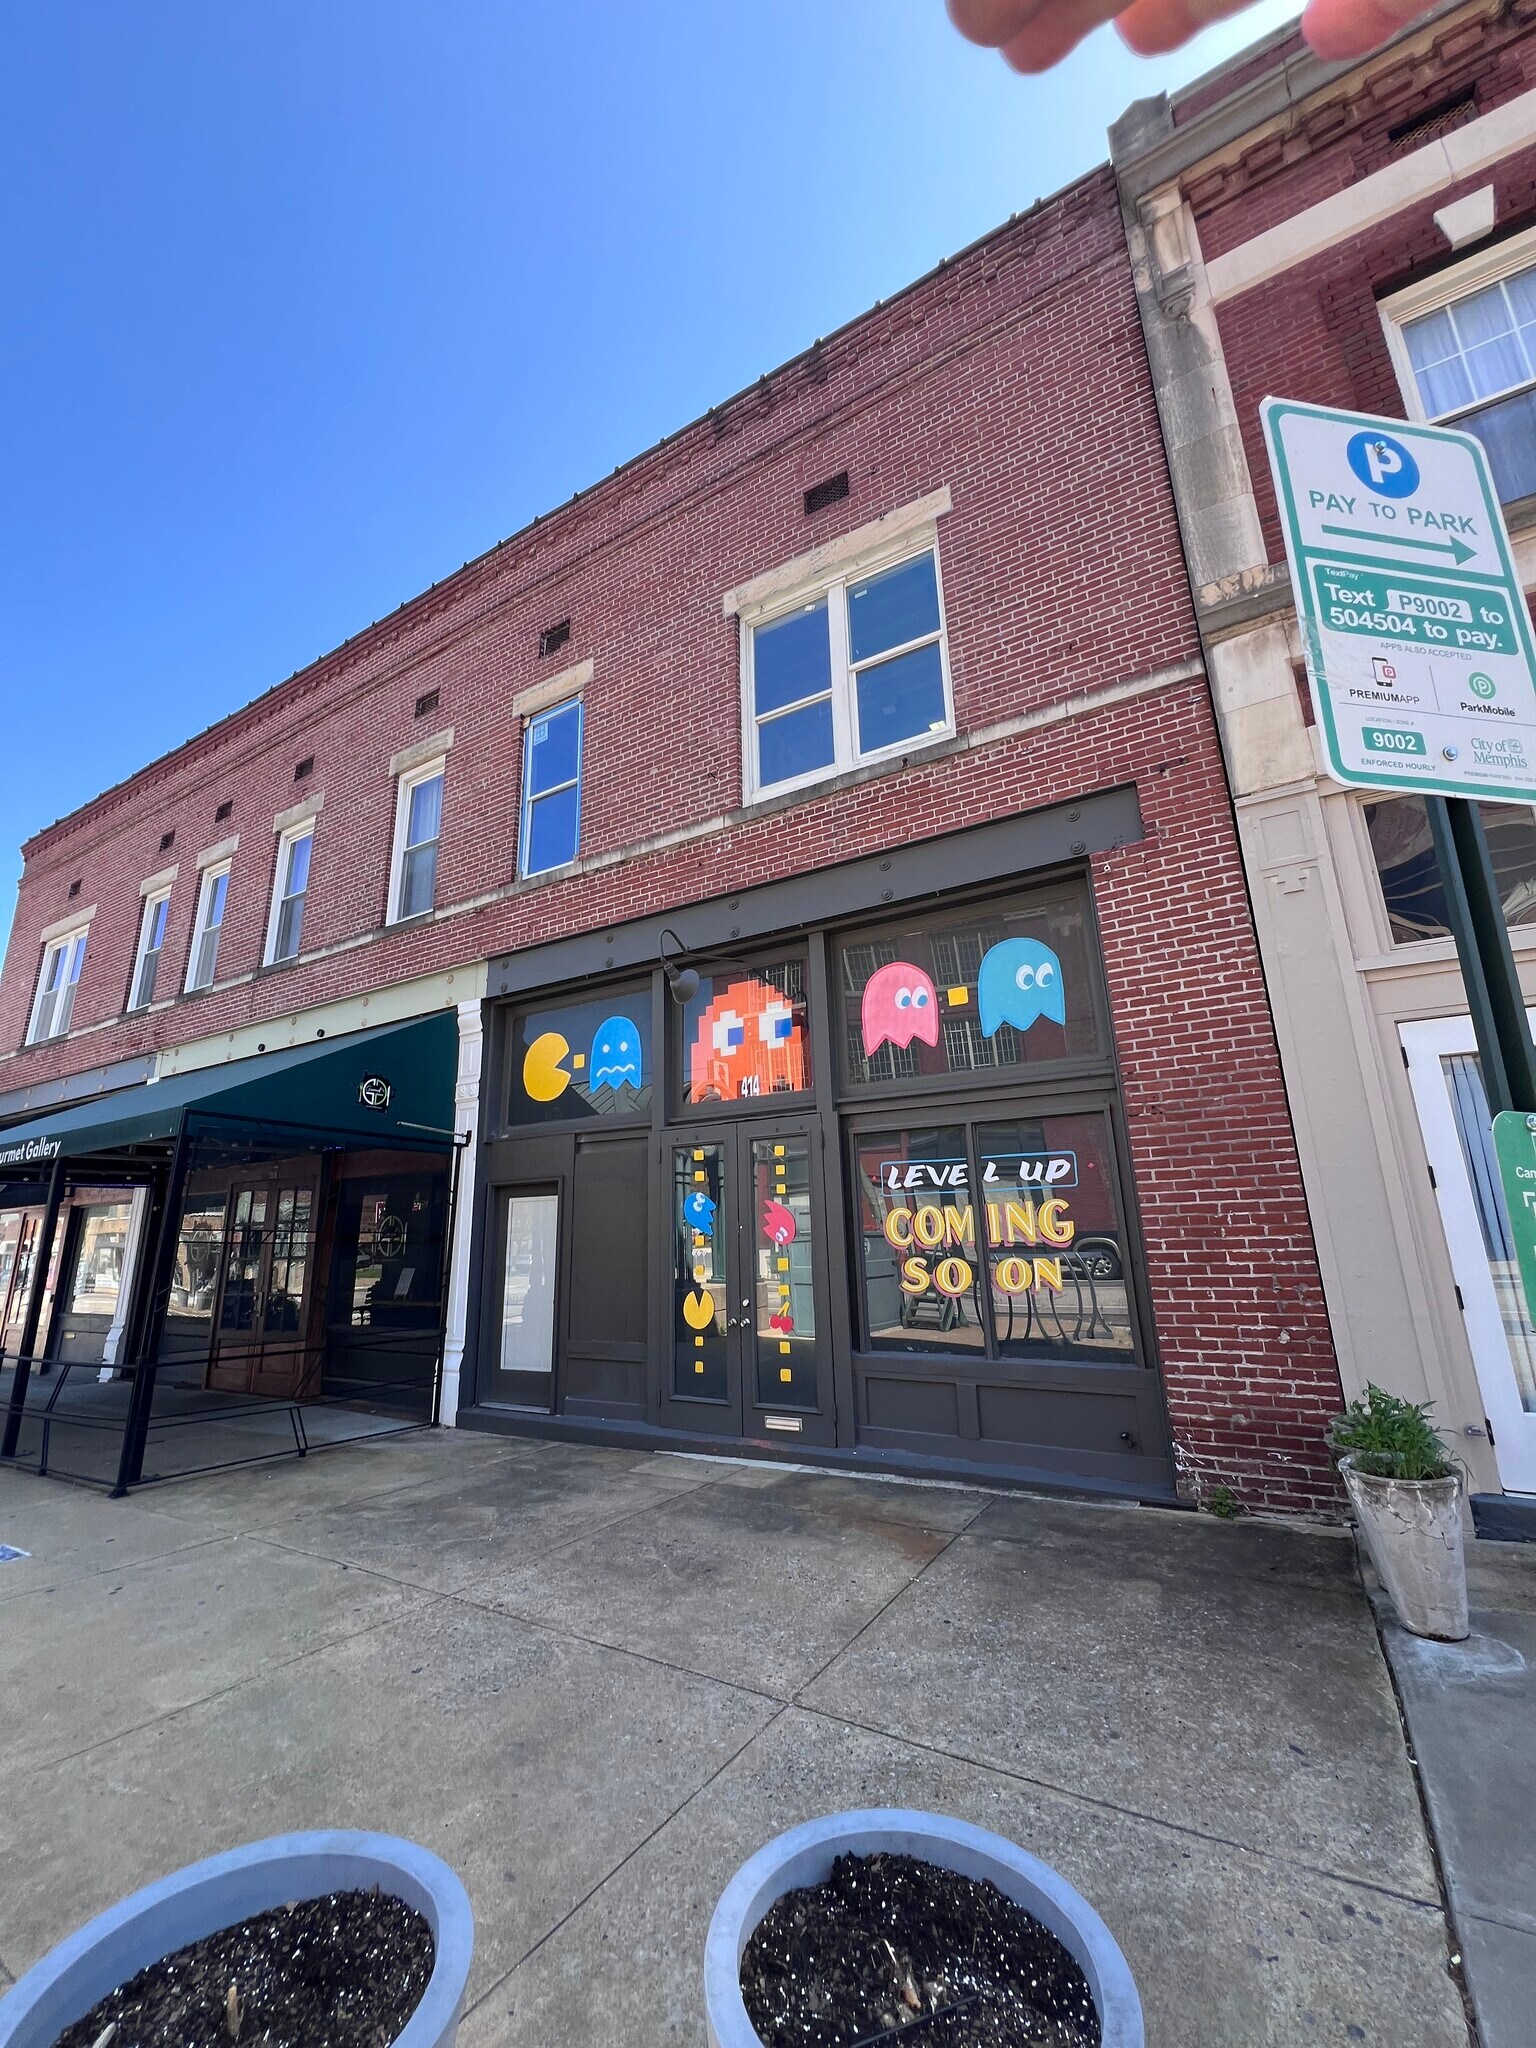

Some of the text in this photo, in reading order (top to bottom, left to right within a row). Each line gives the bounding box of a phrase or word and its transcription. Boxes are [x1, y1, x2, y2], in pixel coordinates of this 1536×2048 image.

[1308, 490, 1478, 535] PAY TO PARK
[1324, 568, 1359, 581] TextPay
[1323, 583, 1504, 625] Text P9002 to
[1330, 607, 1503, 650] 504504 to pay.
[1380, 641, 1472, 661] APPS ALSO ACCEPTED
[1349, 689, 1420, 704] PREMIUMAPP
[1460, 702, 1516, 717] ParkMobile
[1372, 732, 1418, 751] 9002
[1470, 737, 1507, 754] City of
[1361, 758, 1436, 772] ENFORCED HOURLY
[1473, 750, 1529, 769] Memphis
[741, 1074, 760, 1098] 414
[26, 1136, 62, 1160] Gallery
[887, 1158, 1072, 1190] LEVEL UP
[882, 1198, 1076, 1250] COMING
[900, 1256, 1064, 1298] SOON
